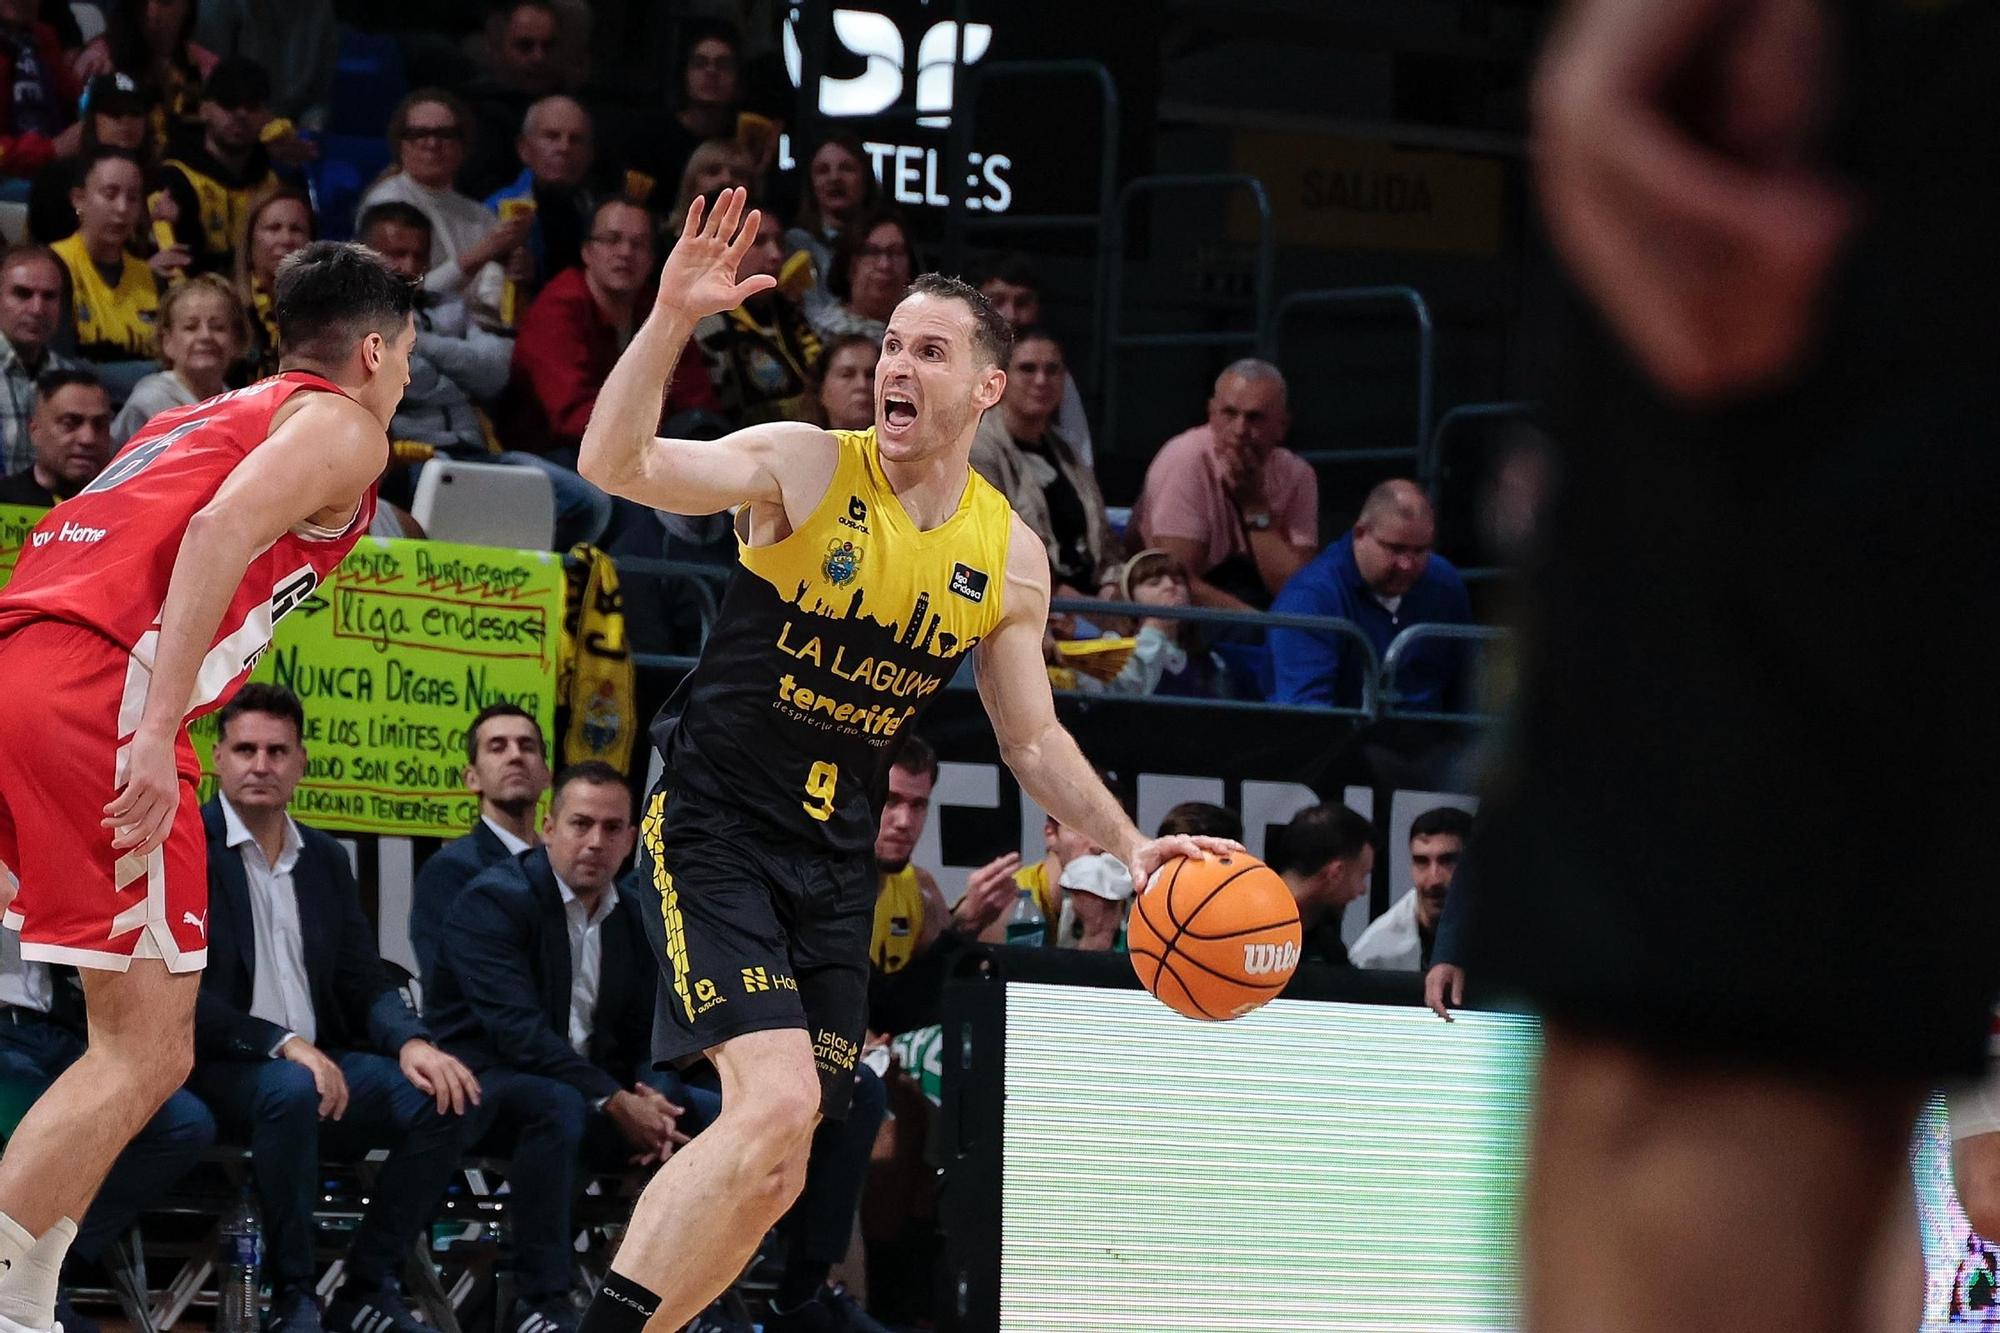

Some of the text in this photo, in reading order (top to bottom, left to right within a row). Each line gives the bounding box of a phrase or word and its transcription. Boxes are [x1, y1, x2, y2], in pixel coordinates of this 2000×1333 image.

[342, 591, 410, 653] liga
[422, 604, 522, 643] endesa
[776, 621, 941, 699] LA LAGUNA
[328, 717, 360, 747] LOS
[352, 756, 388, 783] SON
[801, 760, 838, 822] 9
[817, 1028, 849, 1053] Islas
